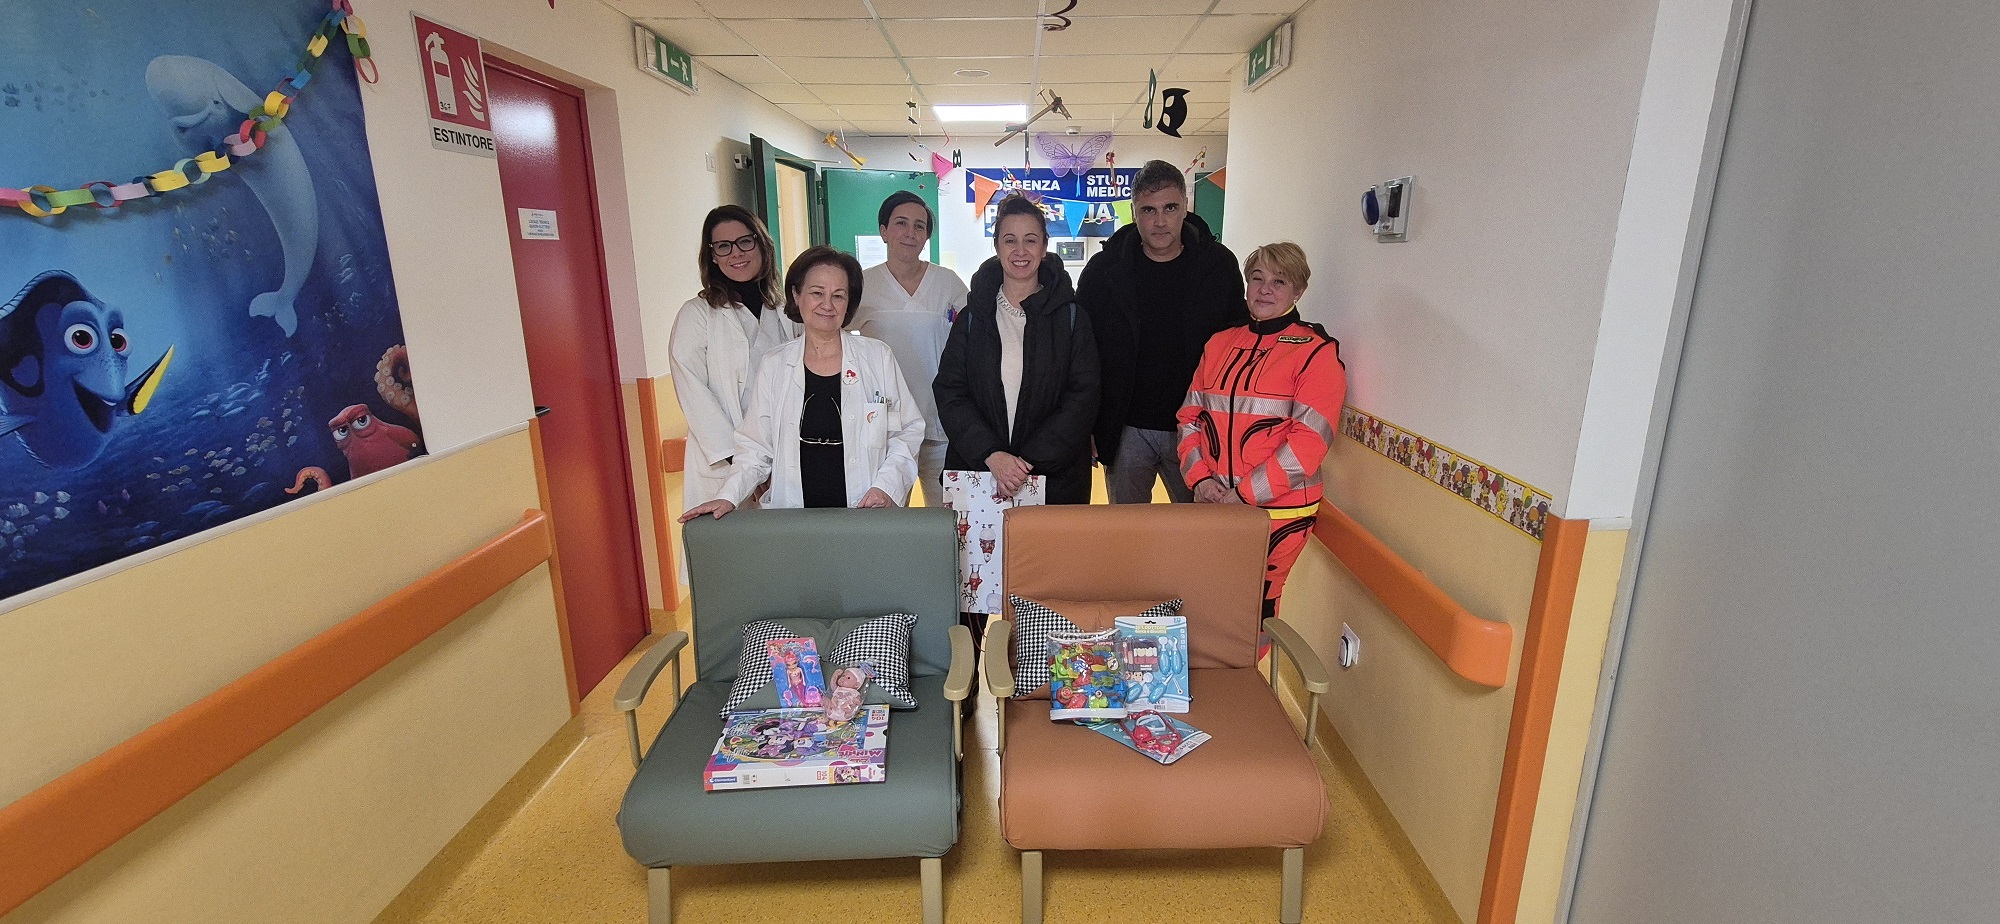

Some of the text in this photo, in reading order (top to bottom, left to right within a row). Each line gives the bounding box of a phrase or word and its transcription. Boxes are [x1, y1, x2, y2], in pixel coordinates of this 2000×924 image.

[433, 127, 494, 151] ESTINTORE
[1086, 174, 1129, 186] STUDI
[1086, 186, 1131, 197] MEDIC
[985, 203, 1112, 223] PATIA
